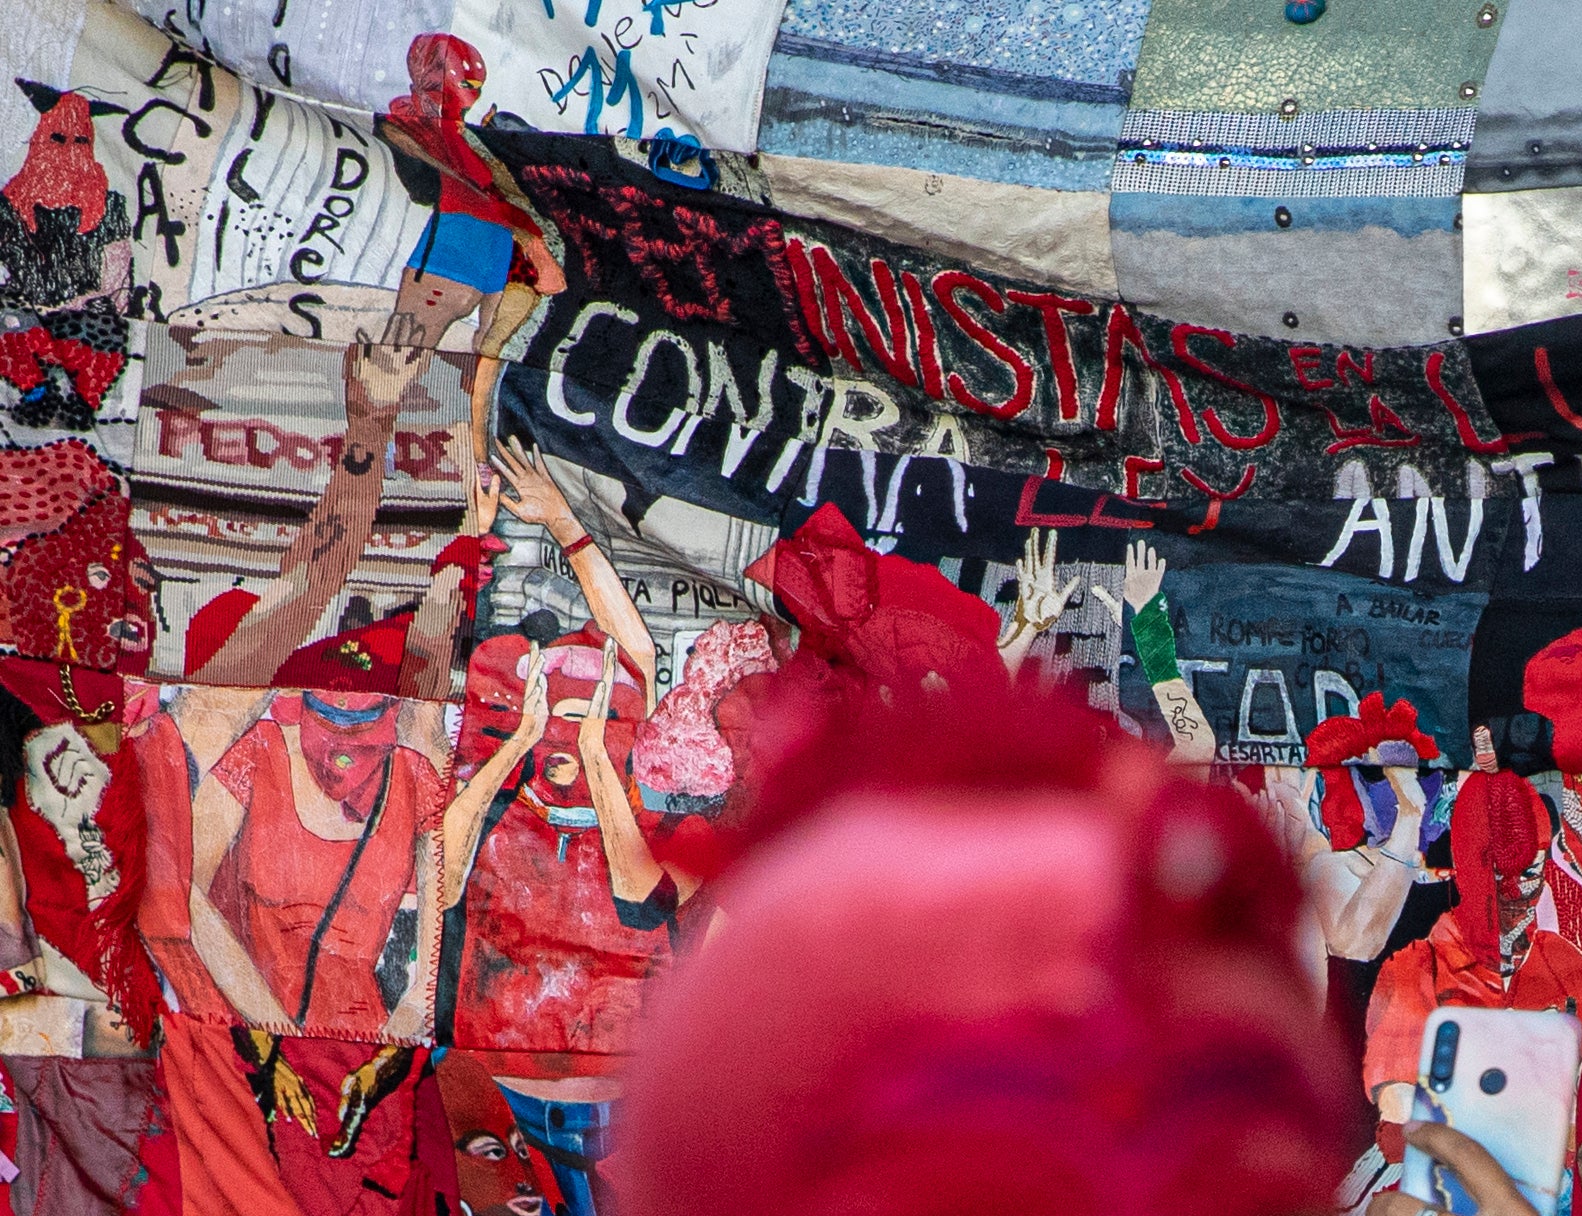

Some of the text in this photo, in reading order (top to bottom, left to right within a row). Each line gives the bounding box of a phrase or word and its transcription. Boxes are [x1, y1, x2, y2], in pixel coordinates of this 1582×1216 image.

[1290, 347, 1374, 391] EN
[546, 301, 968, 534] CONTRA
[1014, 448, 1256, 535] LEY
[1318, 393, 1422, 455] LA
